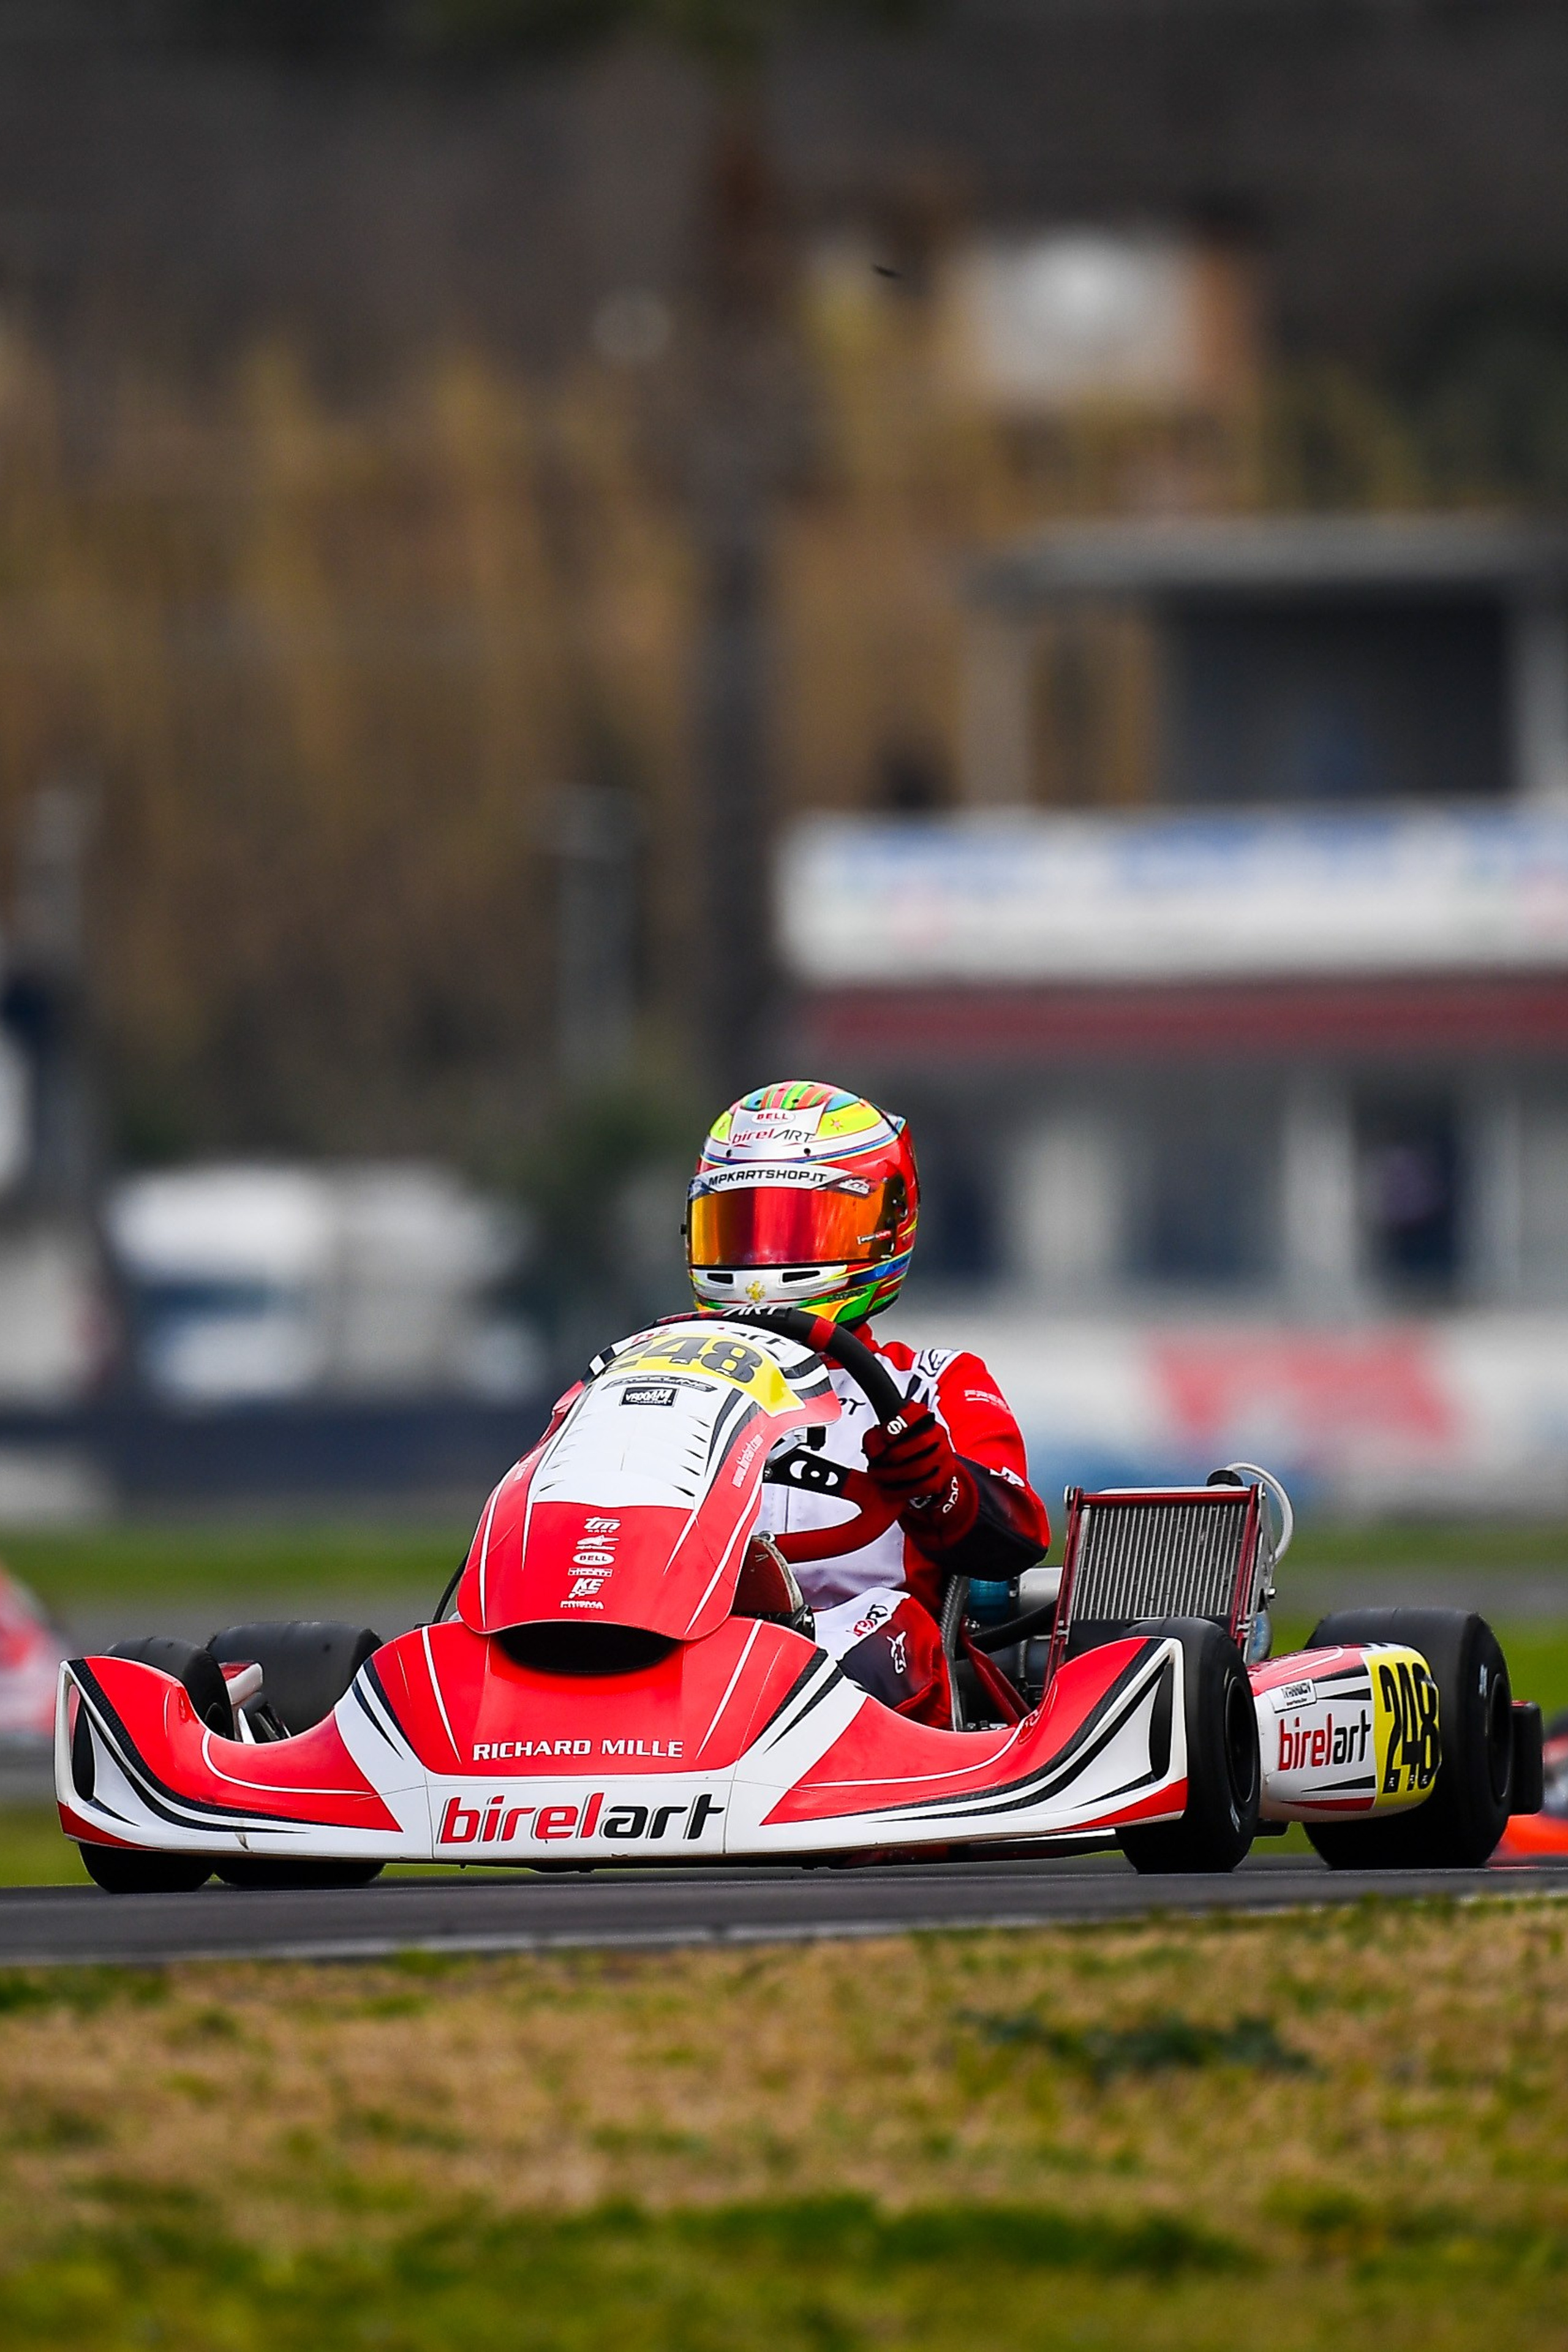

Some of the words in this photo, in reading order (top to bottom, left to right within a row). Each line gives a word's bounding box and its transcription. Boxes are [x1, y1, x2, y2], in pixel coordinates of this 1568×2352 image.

[732, 1128, 815, 1144] birelART
[709, 1169, 827, 1185] MPKARTSHOP.IT
[1278, 1709, 1372, 1771] birelart
[1378, 1662, 1441, 1794] 248
[473, 1740, 591, 1761] RICHARD
[601, 1740, 684, 1758] MILLE
[437, 1792, 725, 1844] birelart
